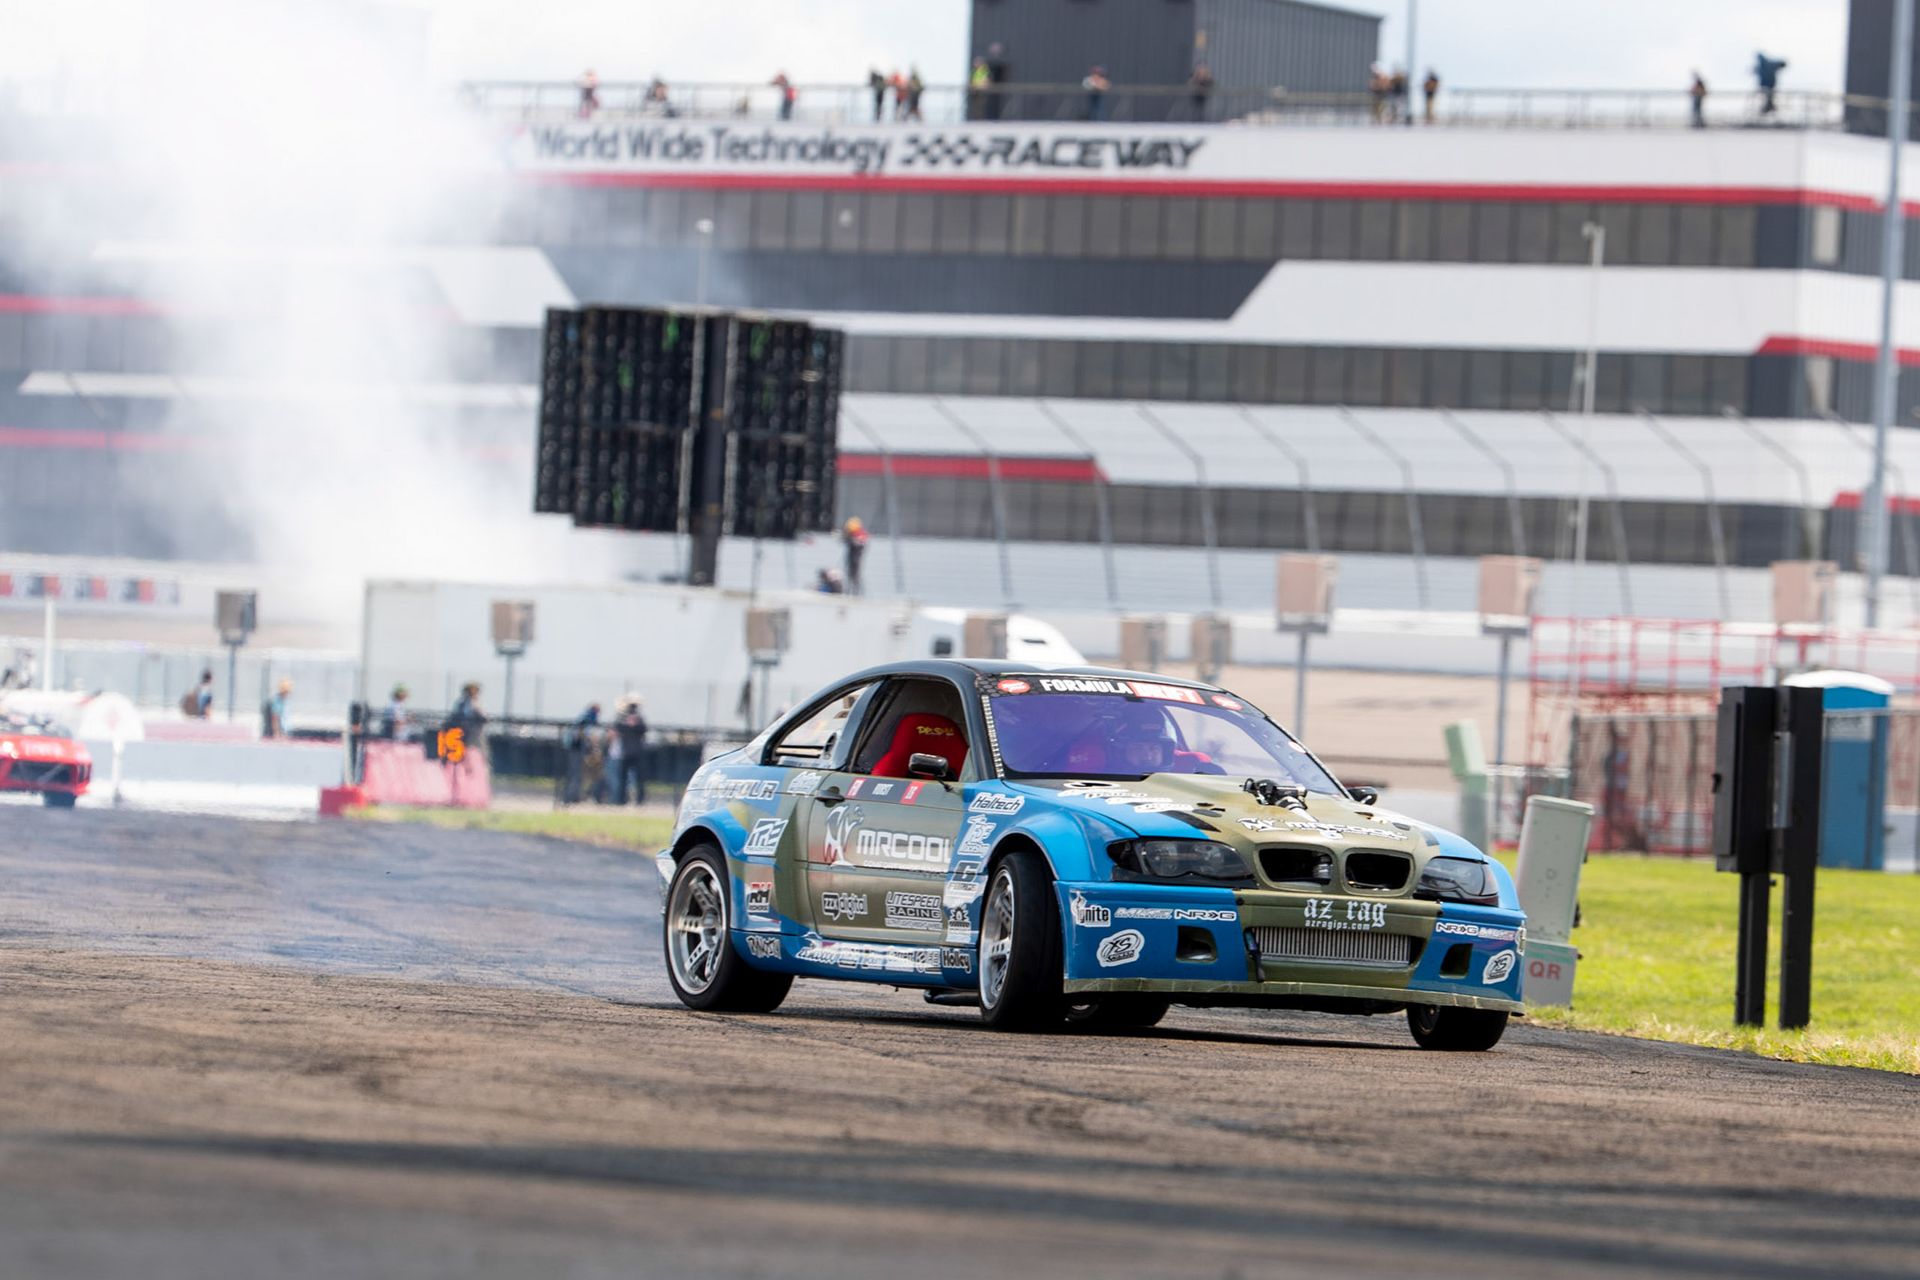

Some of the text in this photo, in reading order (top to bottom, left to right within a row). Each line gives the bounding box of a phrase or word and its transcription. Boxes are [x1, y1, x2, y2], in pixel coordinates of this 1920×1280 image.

[534, 126, 1206, 175] World Wide Technology RACEWAY
[1039, 679, 1133, 694] FORMULA
[971, 796, 1020, 811] Haltech
[856, 829, 951, 864] MRCOOL
[840, 893, 868, 918] digital
[886, 893, 941, 909] LITESPEED
[887, 906, 941, 918] RACING
[1304, 898, 1387, 928] az rag
[1305, 920, 1370, 930] azragips.com
[1106, 937, 1132, 956] XS
[943, 949, 970, 972] Holley
[1529, 960, 1562, 980] QR
